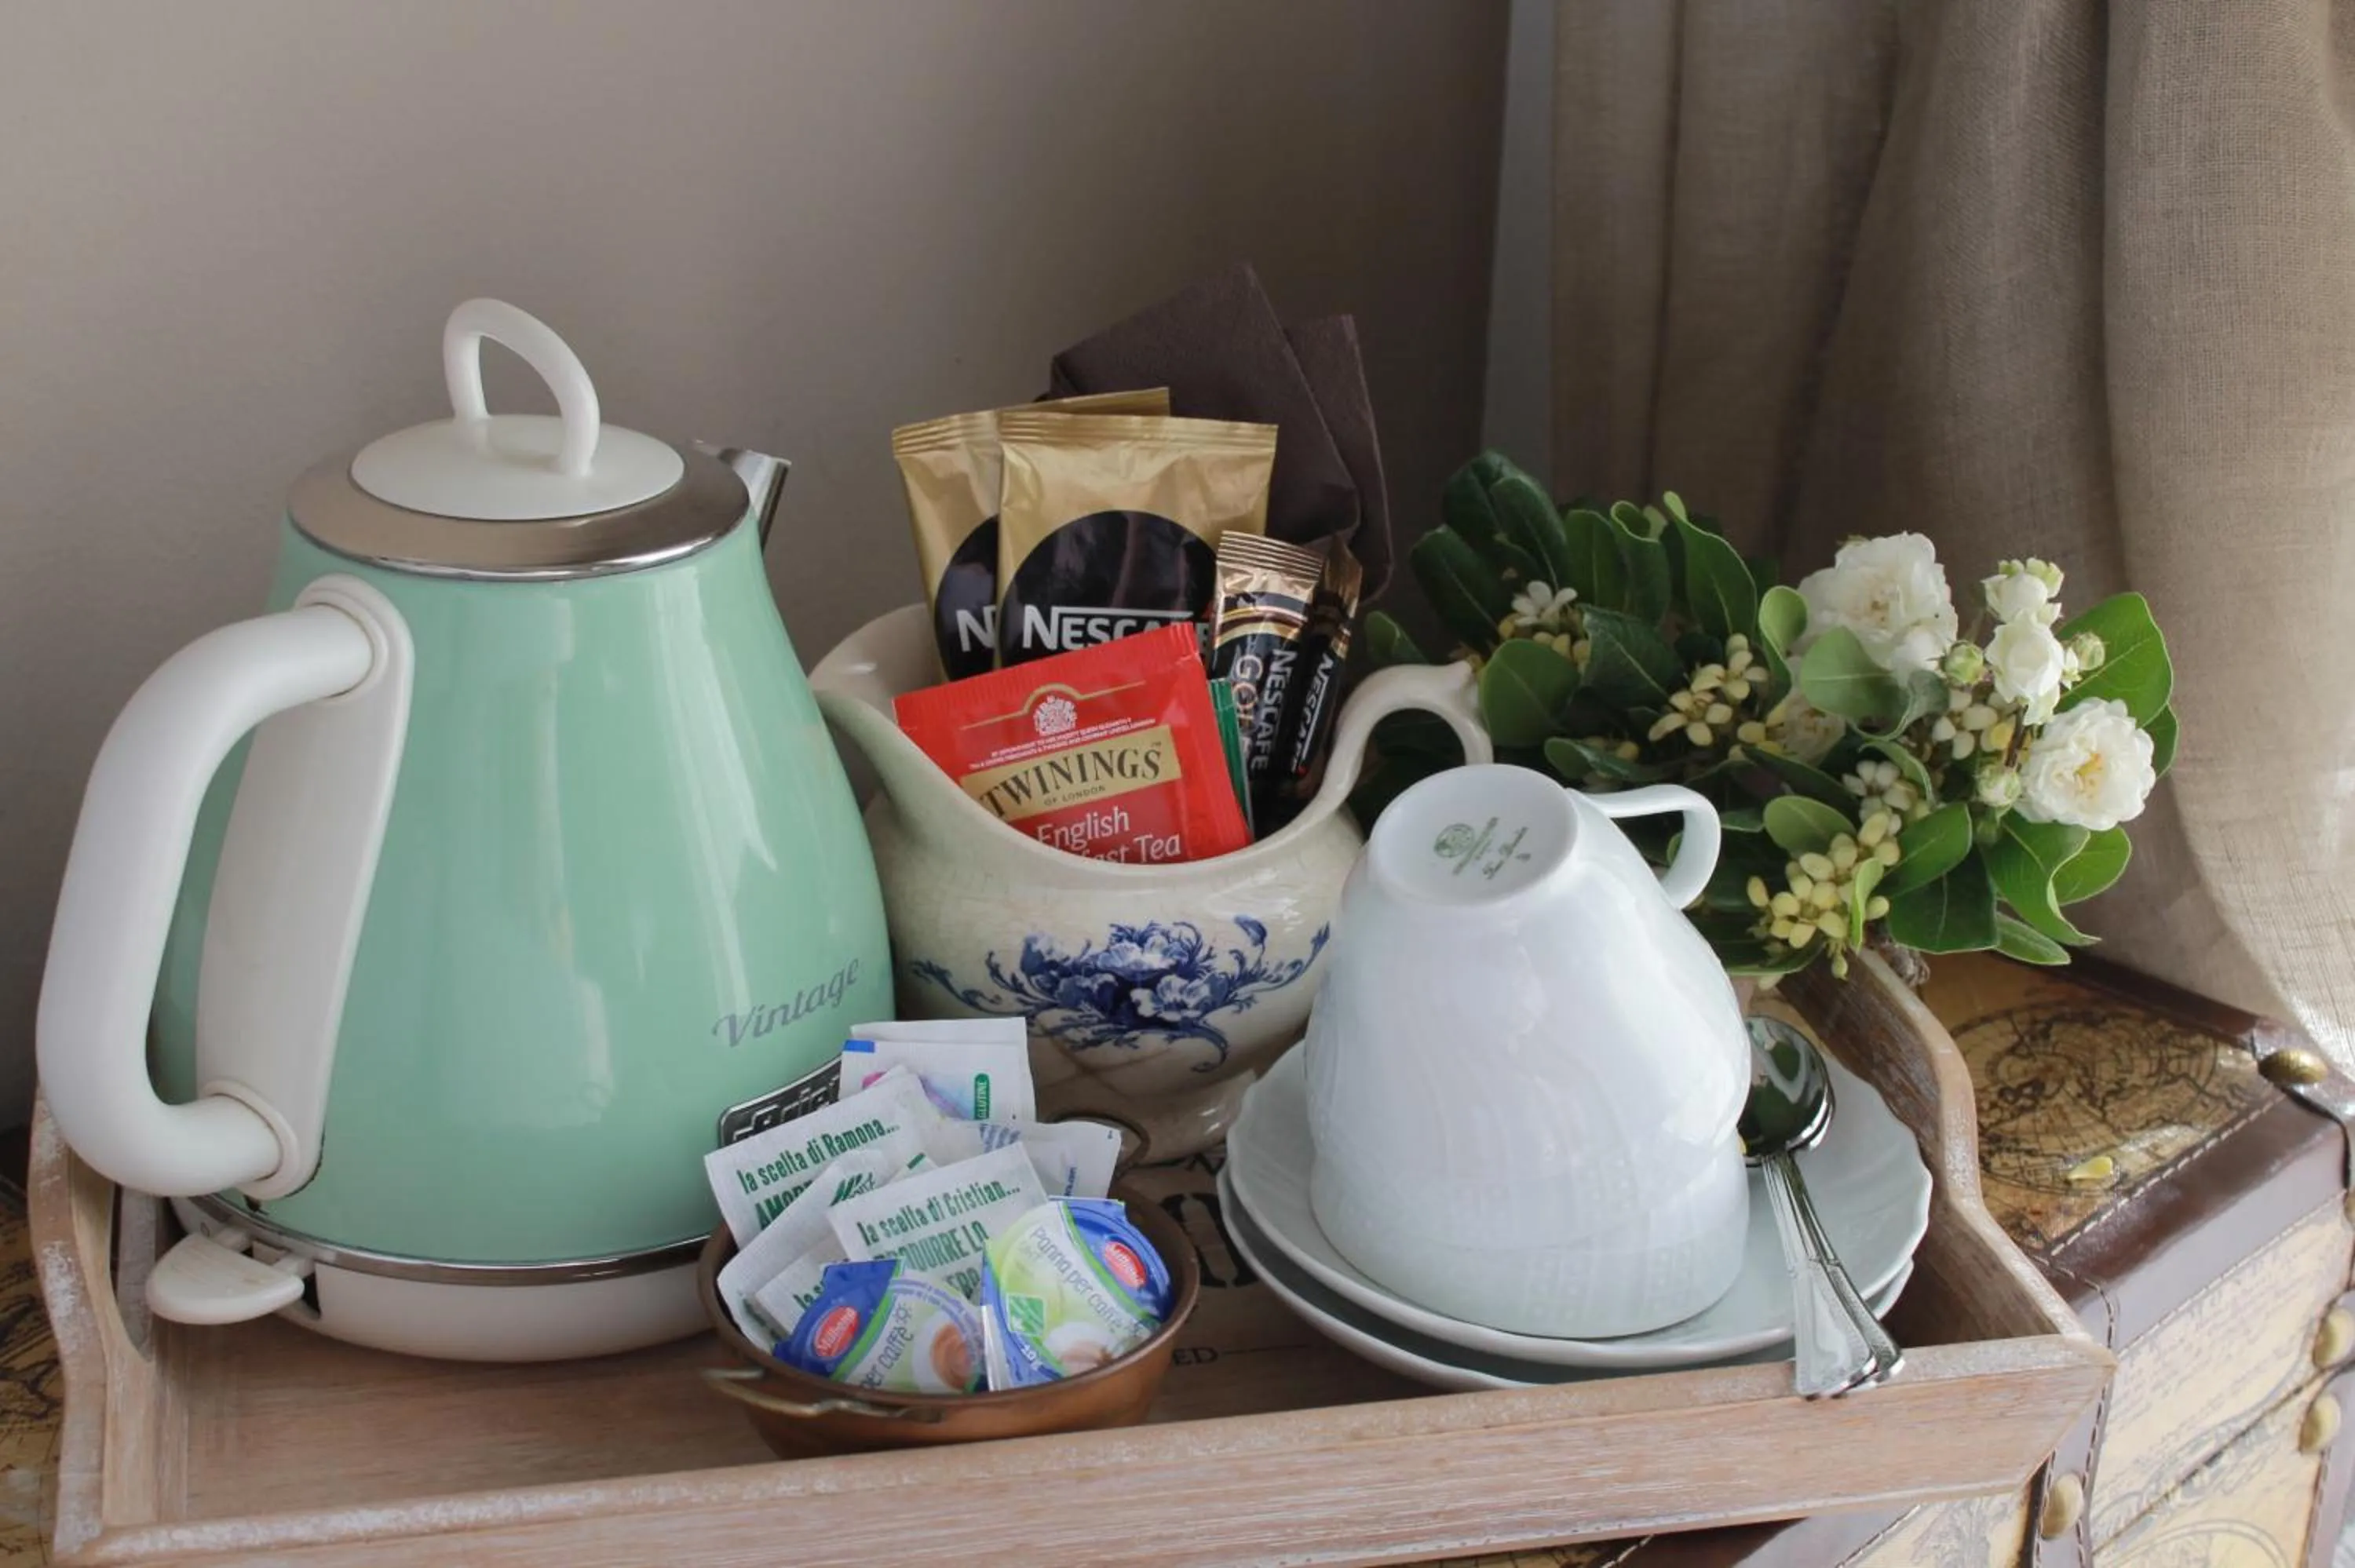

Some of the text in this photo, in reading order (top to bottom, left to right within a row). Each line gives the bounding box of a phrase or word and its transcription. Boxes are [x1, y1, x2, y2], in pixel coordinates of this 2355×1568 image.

[980, 748, 1162, 818] TWININGS
[1044, 786, 1106, 806] OF LONDON
[1037, 805, 1130, 851] English
[1134, 833, 1181, 863] Tea
[711, 958, 859, 1047] Vintage
[736, 1169, 758, 1194] la
[758, 1150, 809, 1186] scelta
[807, 1138, 826, 1166] di
[856, 1221, 879, 1246] la
[878, 1205, 929, 1238] scelta
[926, 1194, 946, 1222] di
[1029, 1227, 1070, 1276] Panna
[1063, 1268, 1094, 1296] per
